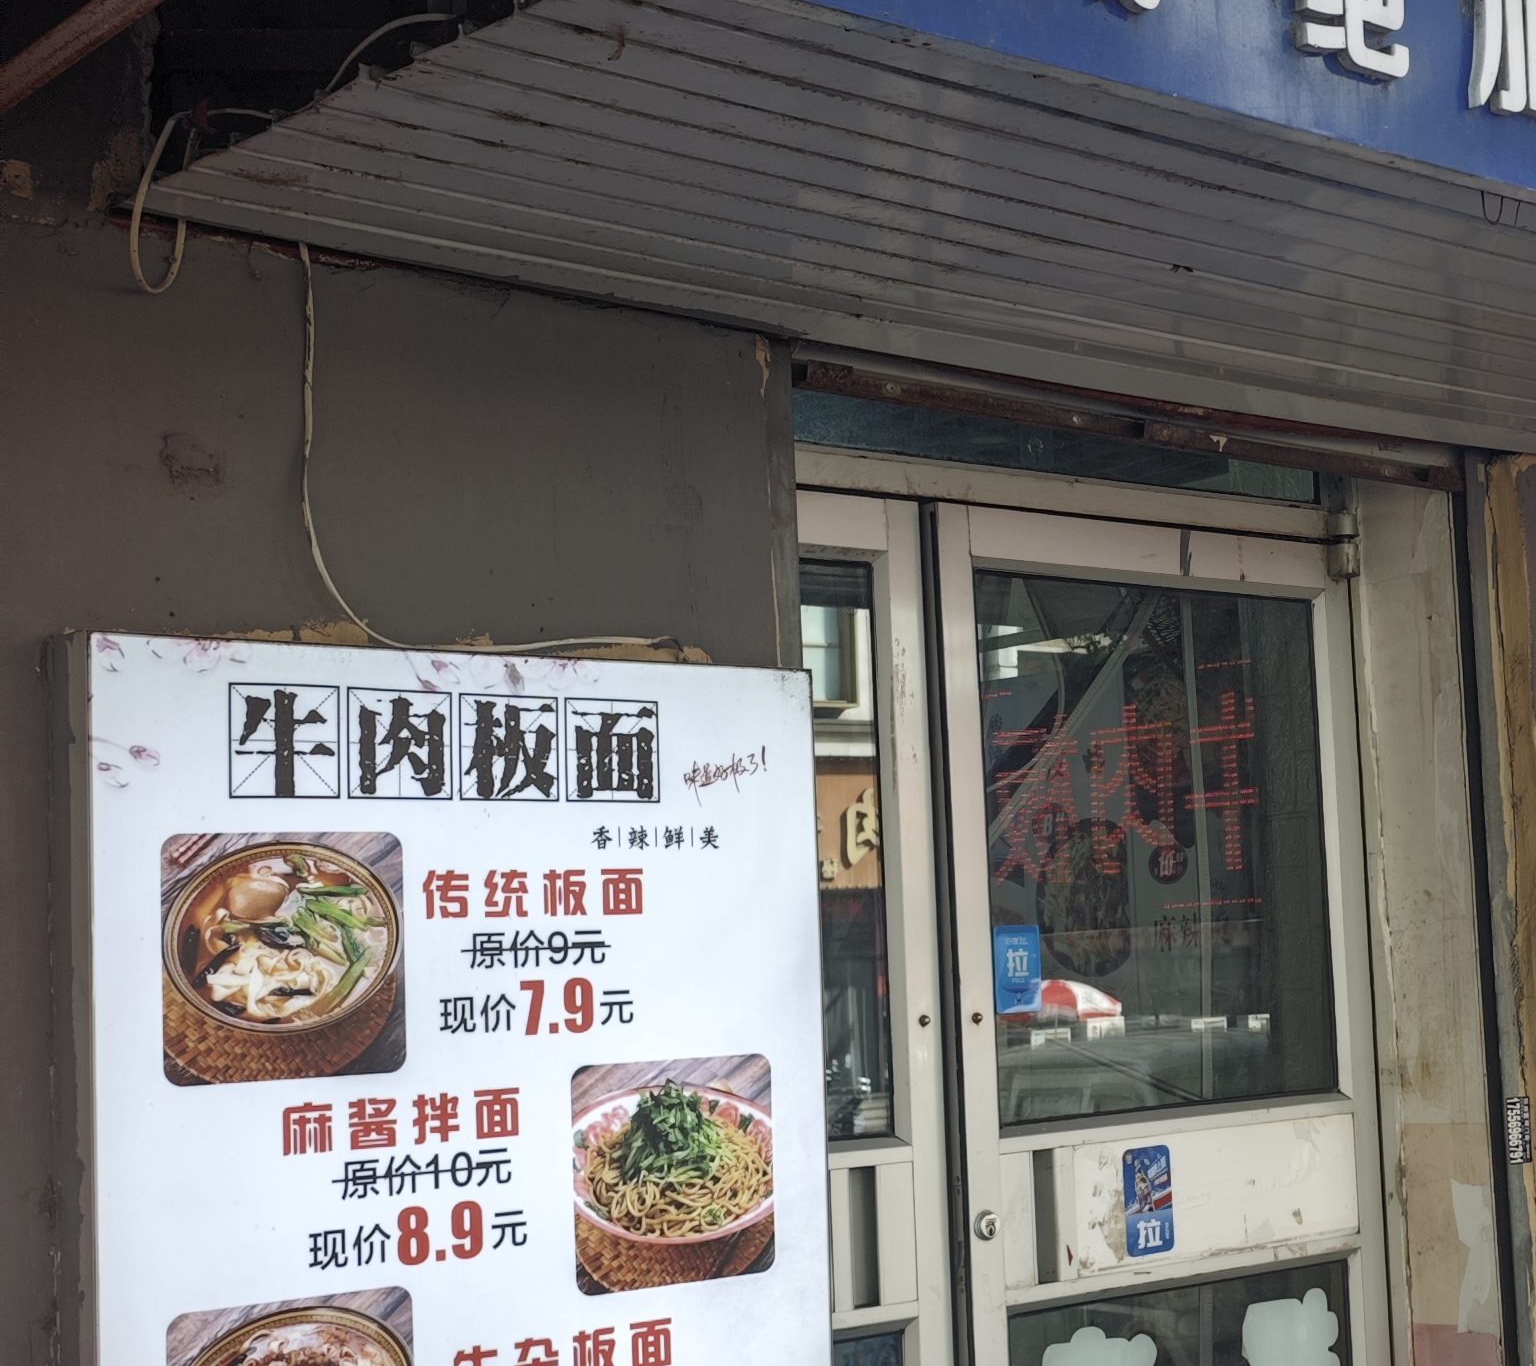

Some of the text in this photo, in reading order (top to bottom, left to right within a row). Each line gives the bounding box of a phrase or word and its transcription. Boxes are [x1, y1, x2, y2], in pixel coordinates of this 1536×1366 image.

[235, 689, 659, 800] 牛肉板面
[422, 867, 644, 919] 传统板面
[469, 929, 606, 970] 原价9元
[1007, 948, 1030, 977] 拉
[439, 977, 635, 1035] 现价7.9元
[282, 1087, 520, 1156] 麻酱拌面
[340, 1148, 512, 1200] 原价10元
[308, 1200, 528, 1270] 现价8.9元
[1136, 1218, 1163, 1249] 拉
